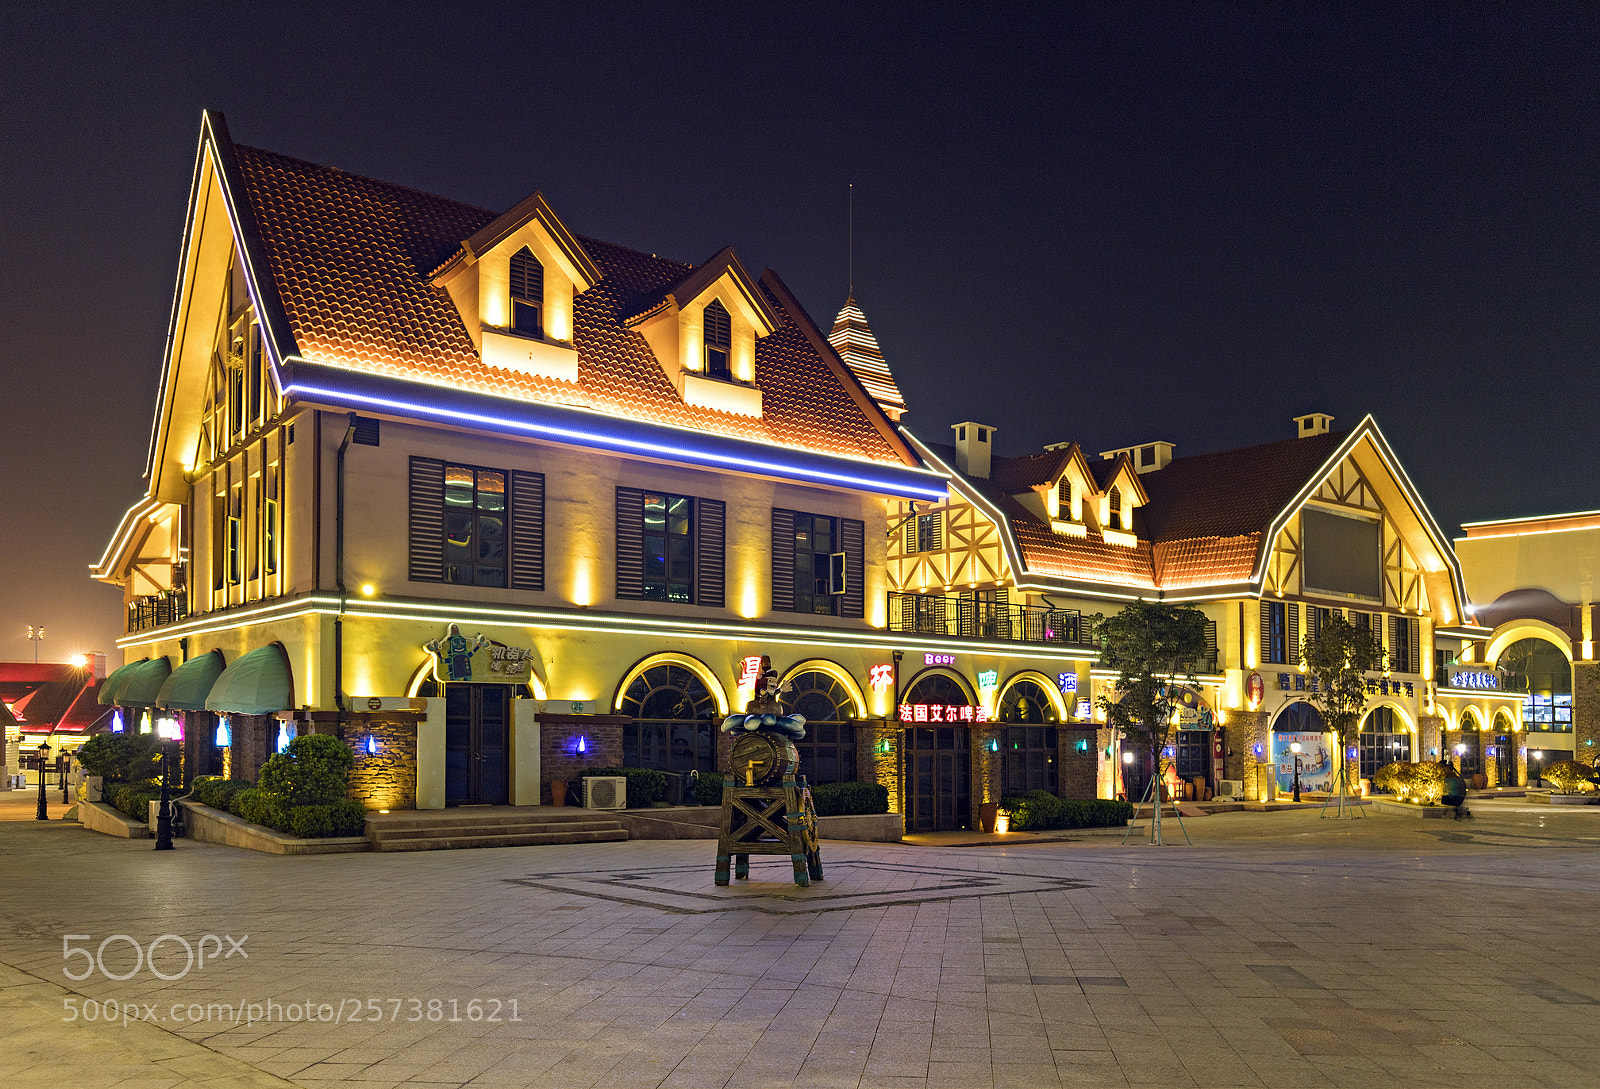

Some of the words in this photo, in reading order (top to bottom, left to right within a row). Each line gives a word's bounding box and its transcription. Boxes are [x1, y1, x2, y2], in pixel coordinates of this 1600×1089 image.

[491, 646, 534, 660] 机器人
[924, 652, 956, 665] Beer
[899, 703, 989, 723] 法国艾尔啤酒
